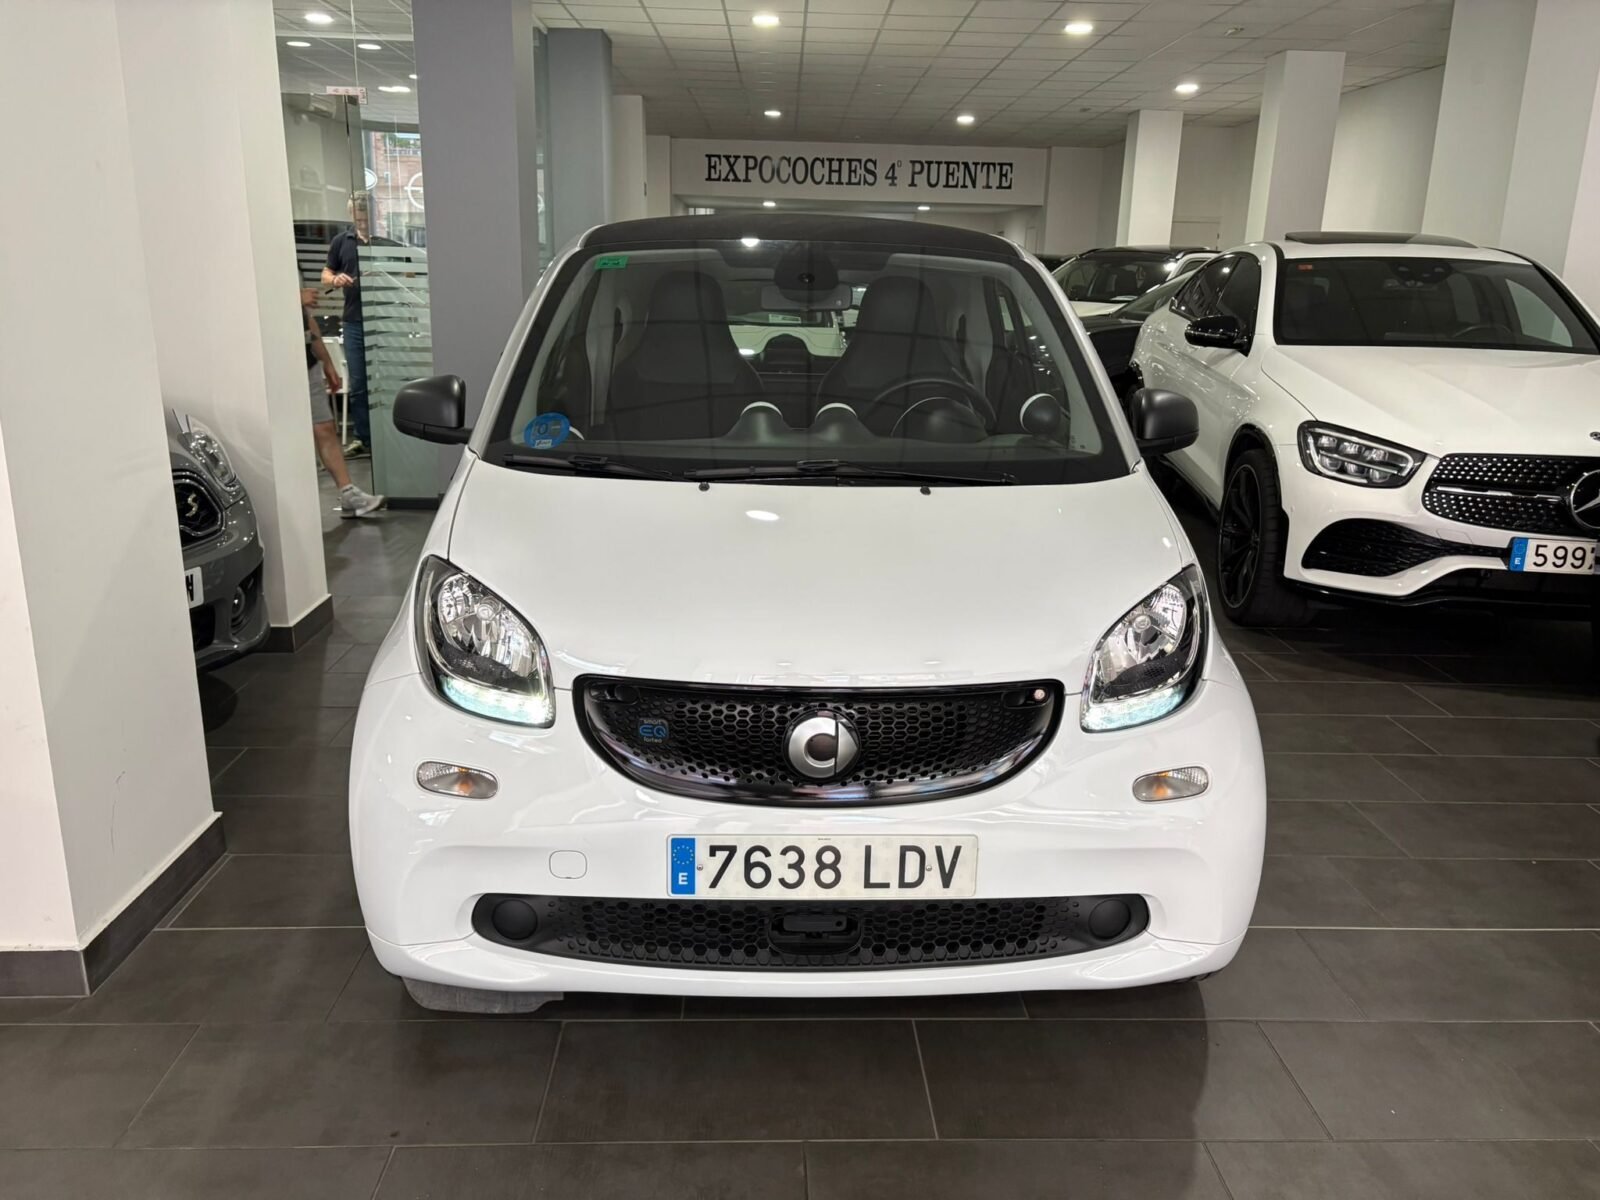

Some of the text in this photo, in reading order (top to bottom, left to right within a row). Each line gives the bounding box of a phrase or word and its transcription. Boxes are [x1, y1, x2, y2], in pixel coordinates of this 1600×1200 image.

[705, 154, 878, 186] EXPOCOCHES
[908, 160, 1013, 189] PUENTE
[640, 725, 666, 737] EQ
[678, 872, 688, 885] E
[708, 844, 963, 890] 7638 LDV
